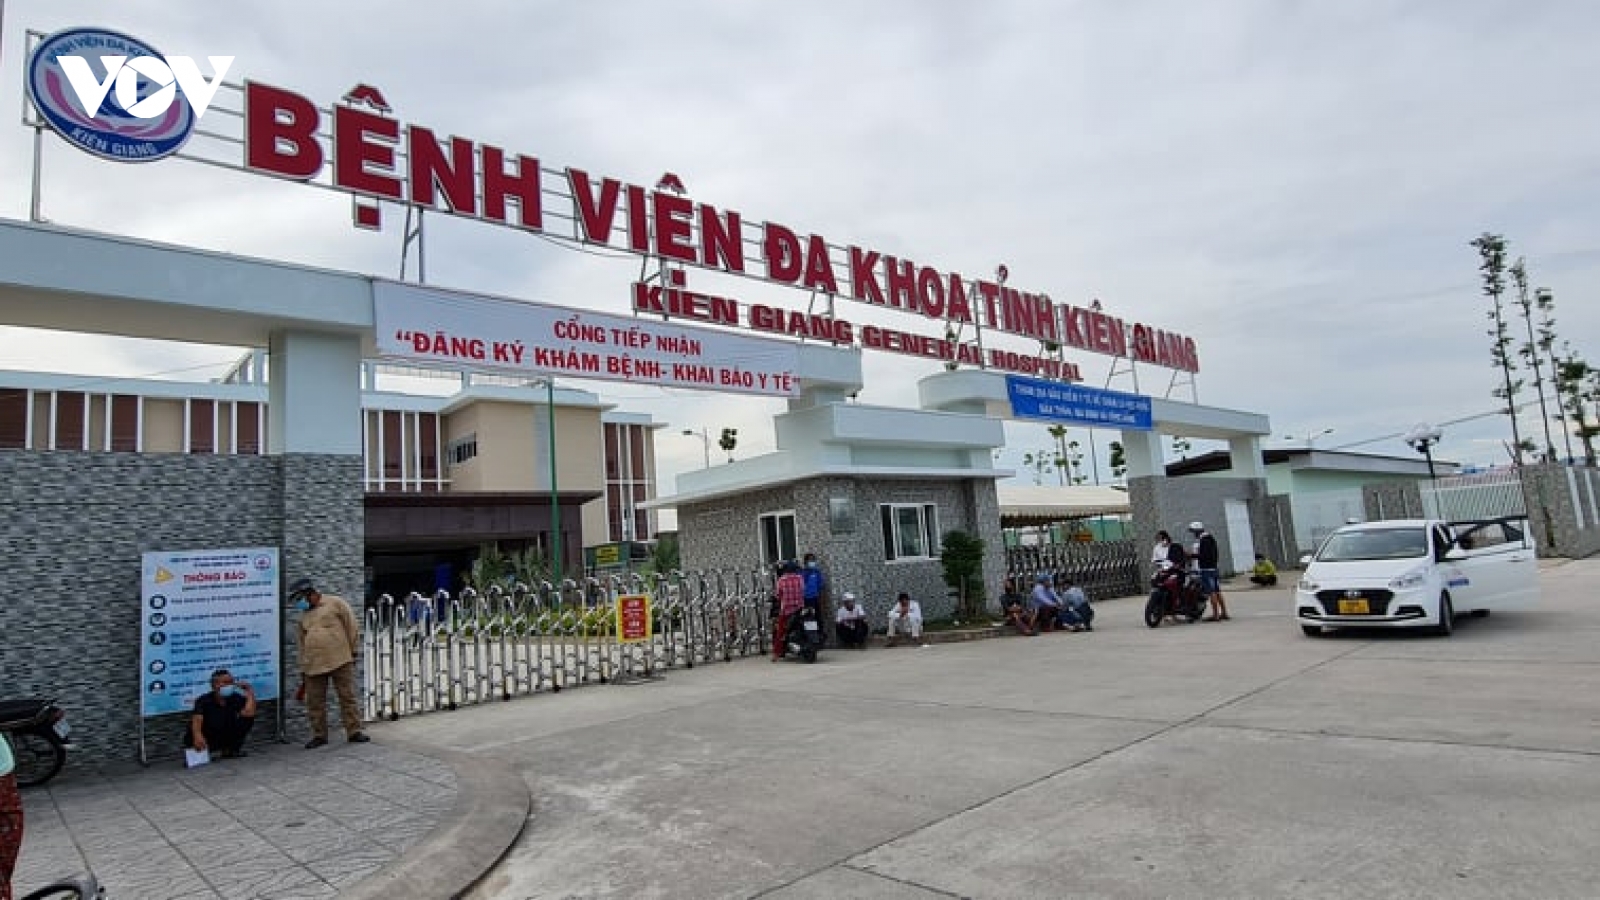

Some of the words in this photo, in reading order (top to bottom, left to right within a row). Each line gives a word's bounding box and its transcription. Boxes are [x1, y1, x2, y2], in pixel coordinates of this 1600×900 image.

[245, 82, 542, 229] BỆNH
[566, 168, 744, 286] VIỆN
[761, 220, 837, 293] ĐA
[847, 245, 972, 322] KHOA
[976, 264, 1057, 345] TỈNH
[1060, 298, 1127, 358] KIÊN
[1132, 322, 1199, 374] GIANG
[493, 339, 525, 364] KÝ
[535, 346, 600, 373] KHÁM
[673, 362, 715, 384] KHAI
[721, 364, 754, 389] BÁO
[758, 372, 768, 390] Y
[553, 314, 606, 345] CỔNG
[610, 325, 651, 350] TIẾP
[656, 335, 702, 358] NHẬN
[749, 304, 853, 343] GIANG
[861, 325, 984, 367] GENERAL
[991, 349, 1085, 382] HOSPITAL
